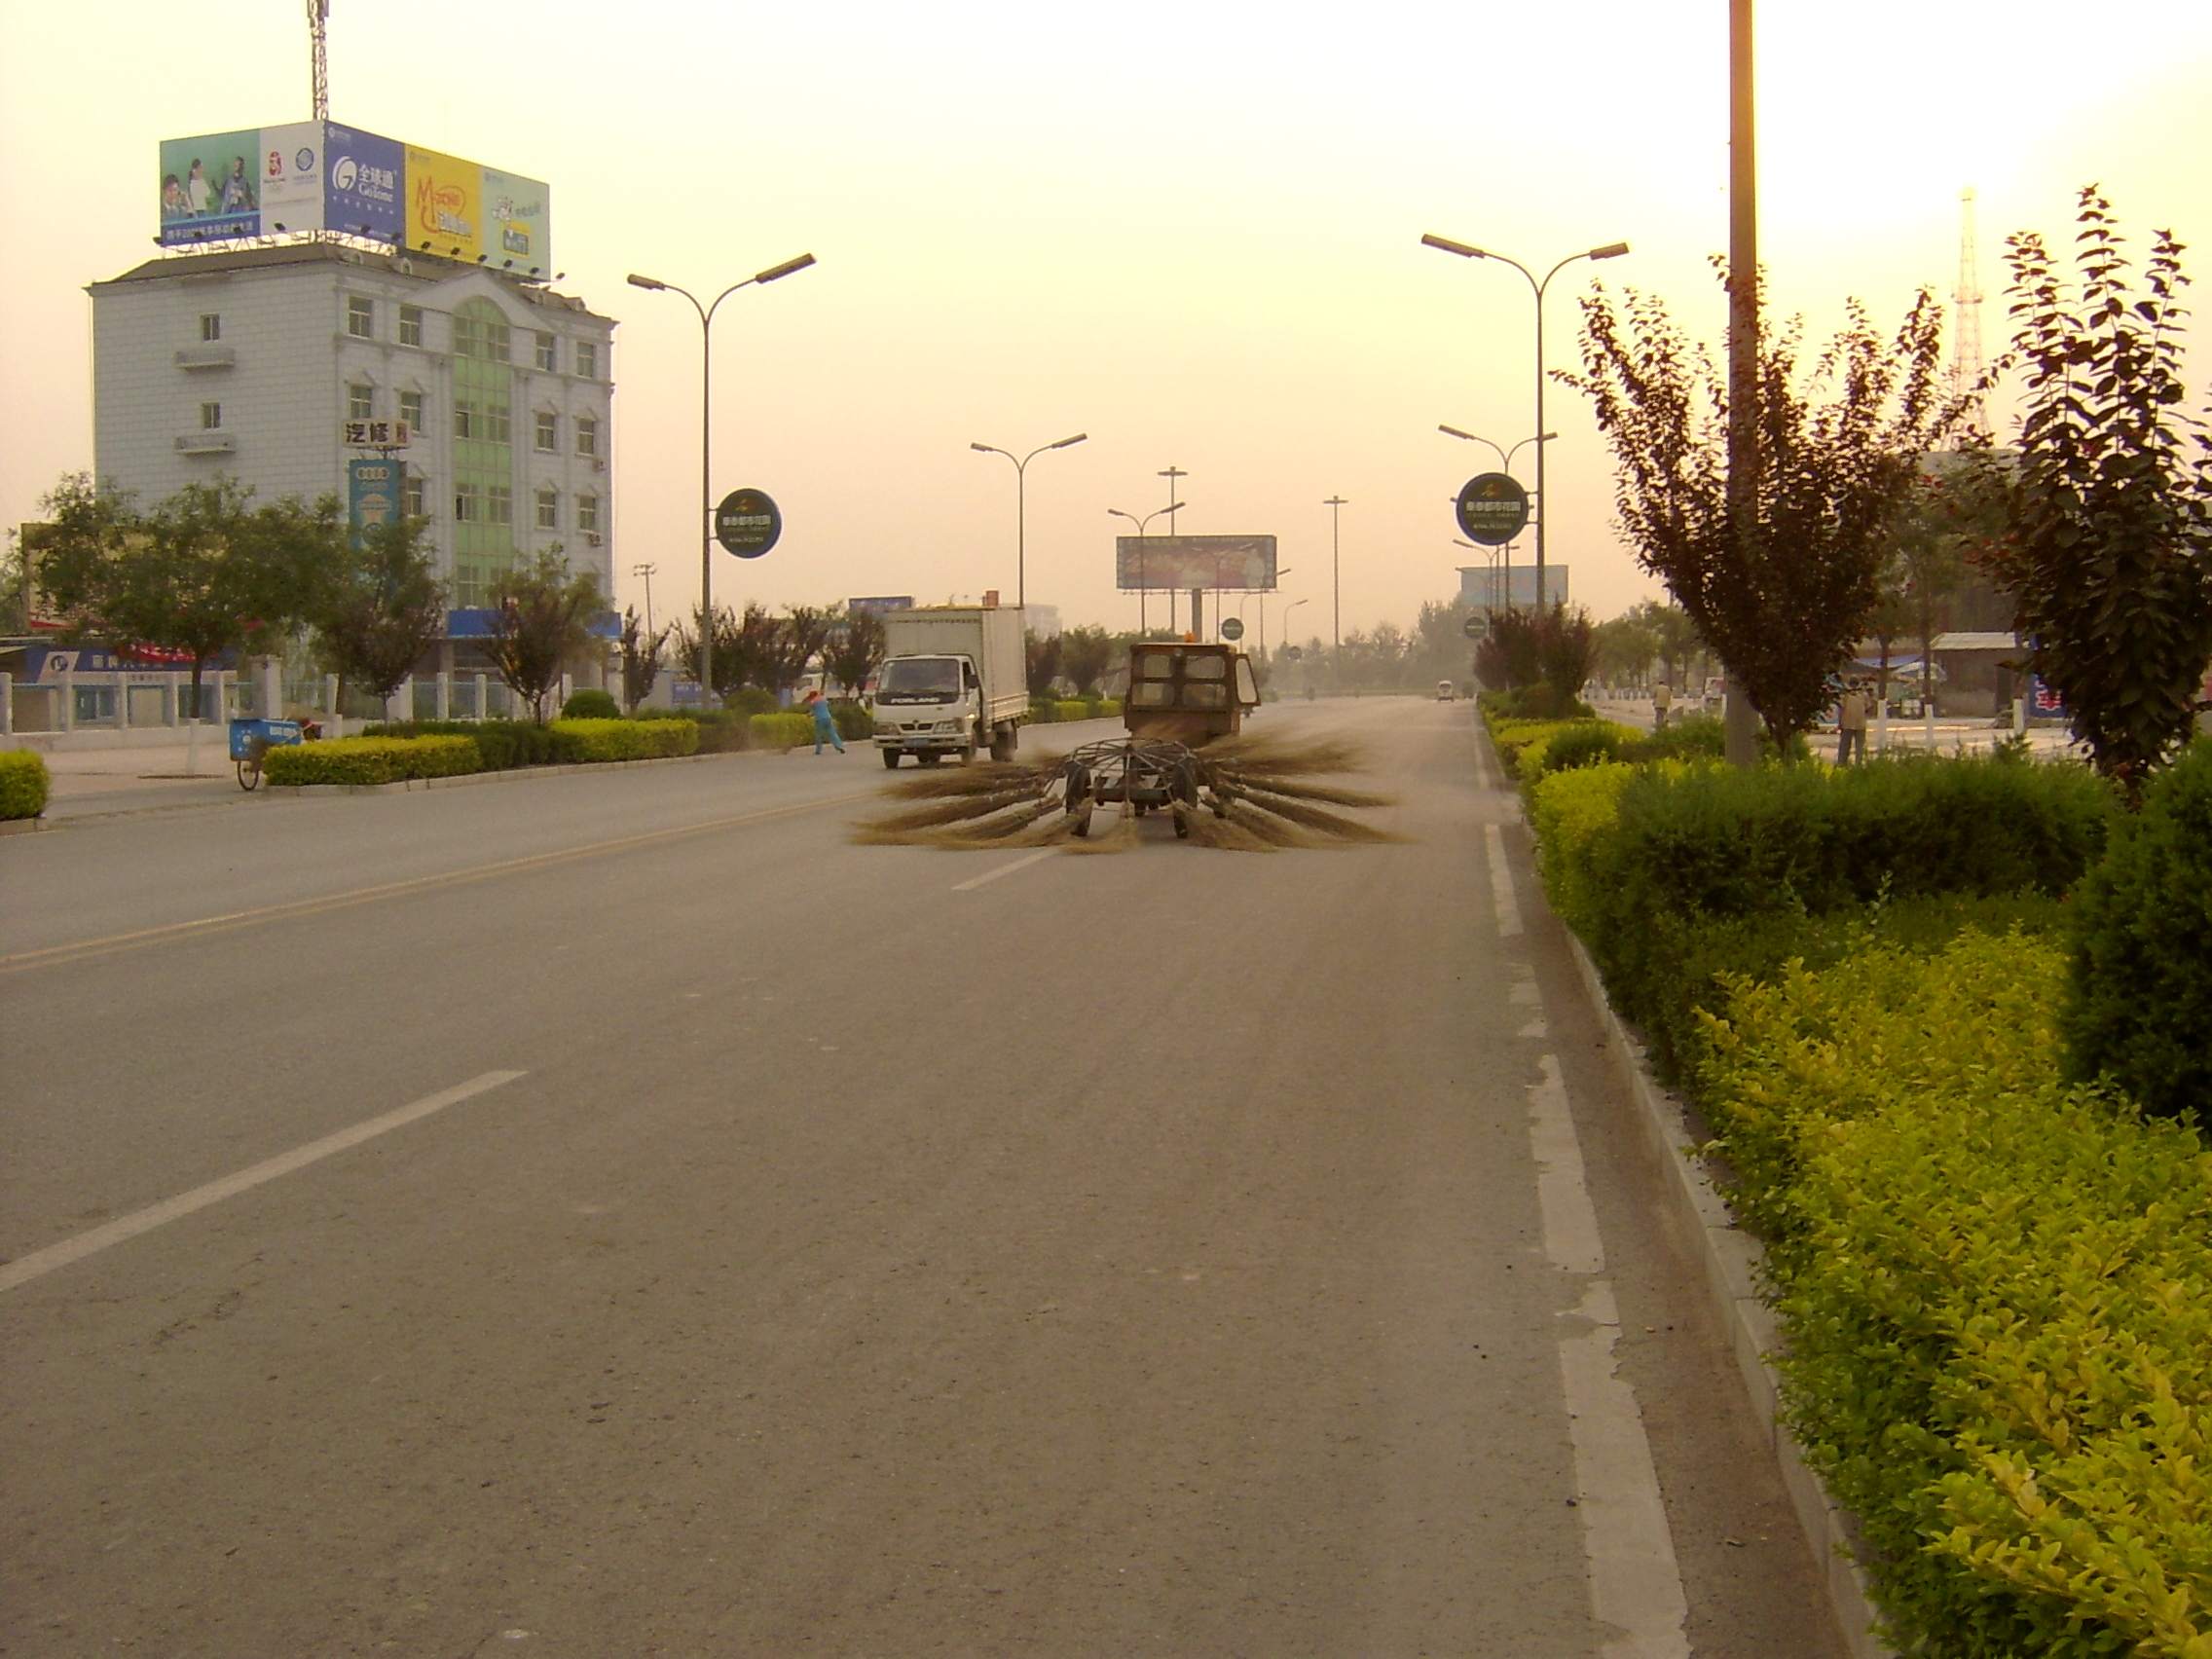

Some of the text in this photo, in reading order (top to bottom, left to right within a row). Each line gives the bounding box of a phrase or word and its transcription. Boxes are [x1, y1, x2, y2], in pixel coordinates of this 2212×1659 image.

[358, 164, 394, 190] 全球通
[346, 422, 389, 444] 汽修
